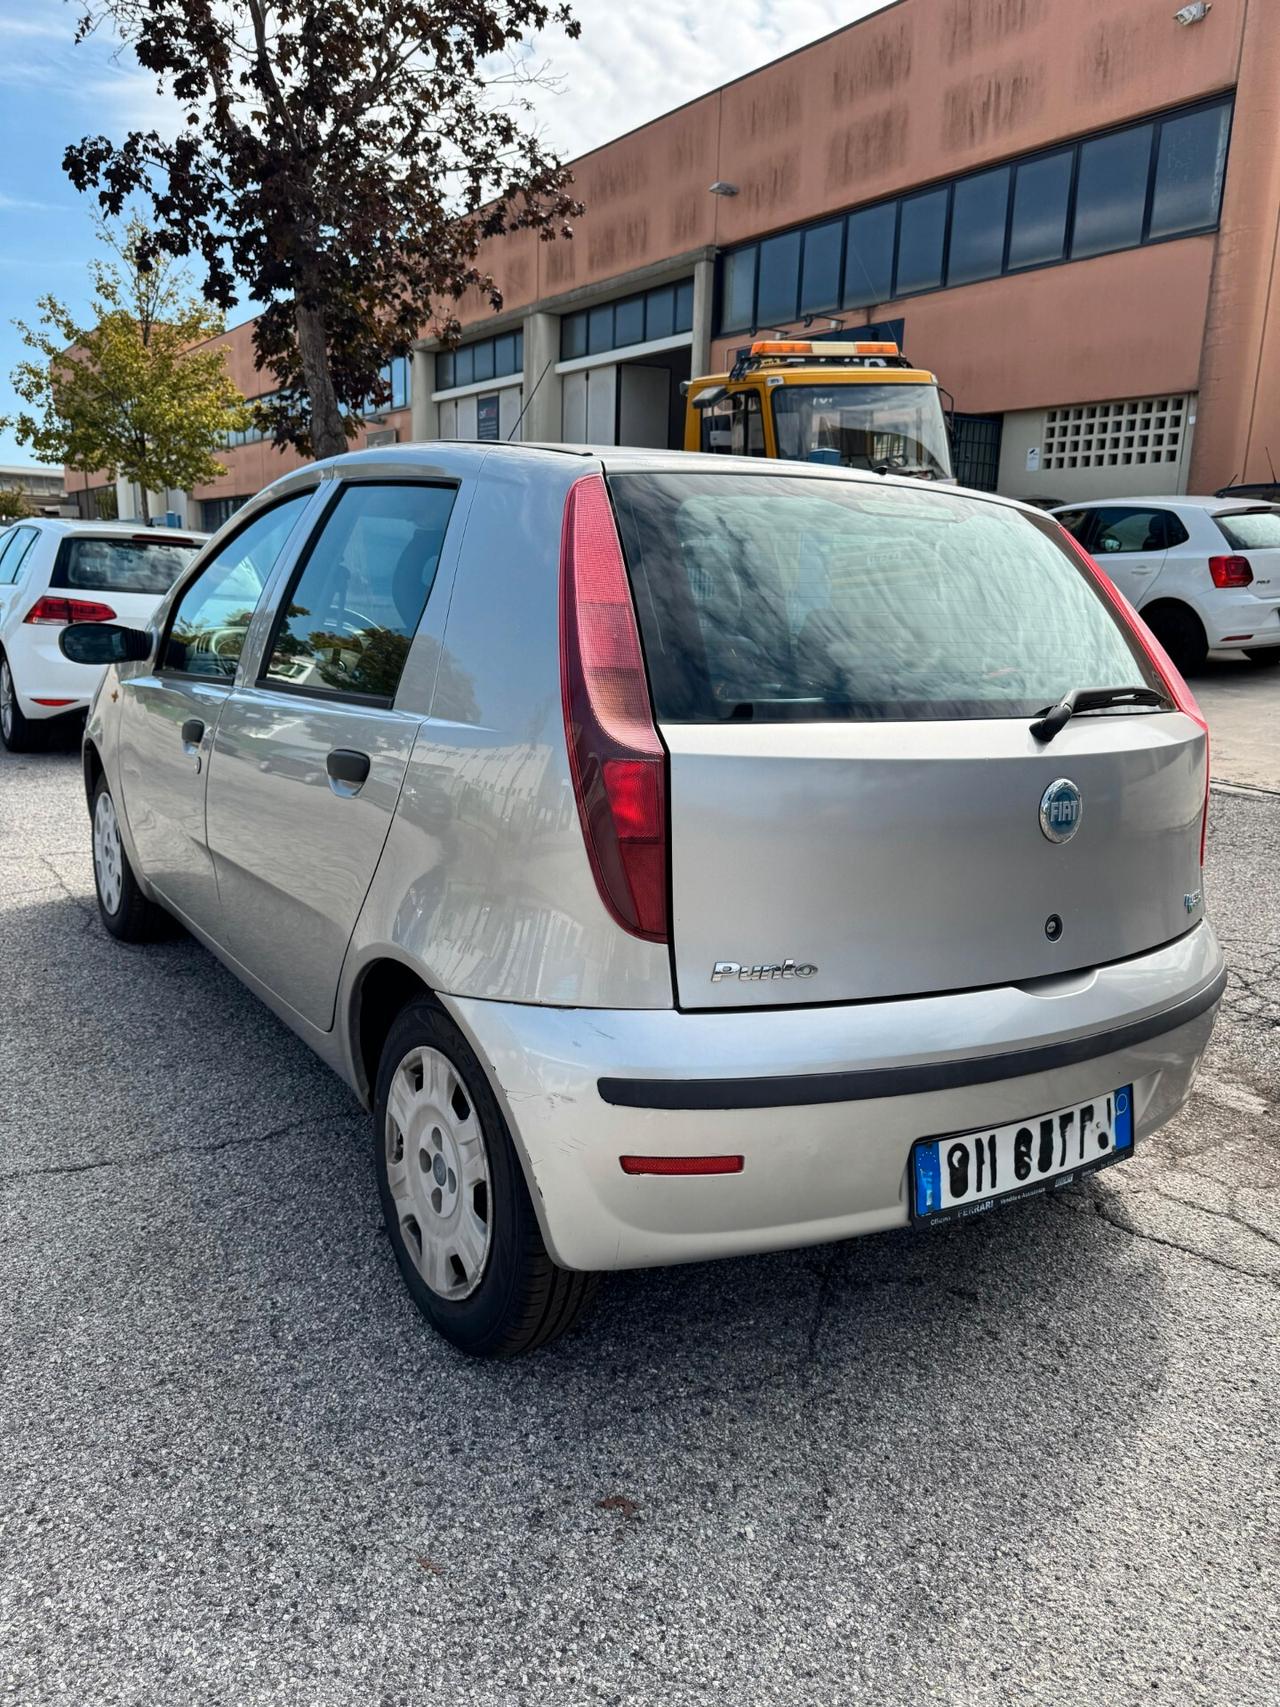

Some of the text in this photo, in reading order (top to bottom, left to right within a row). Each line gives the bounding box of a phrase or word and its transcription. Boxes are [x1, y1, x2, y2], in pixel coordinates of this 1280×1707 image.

[1050, 800, 1078, 822] FIAT
[711, 958, 818, 982] Punto
[957, 1200, 994, 1218] FERRARI
